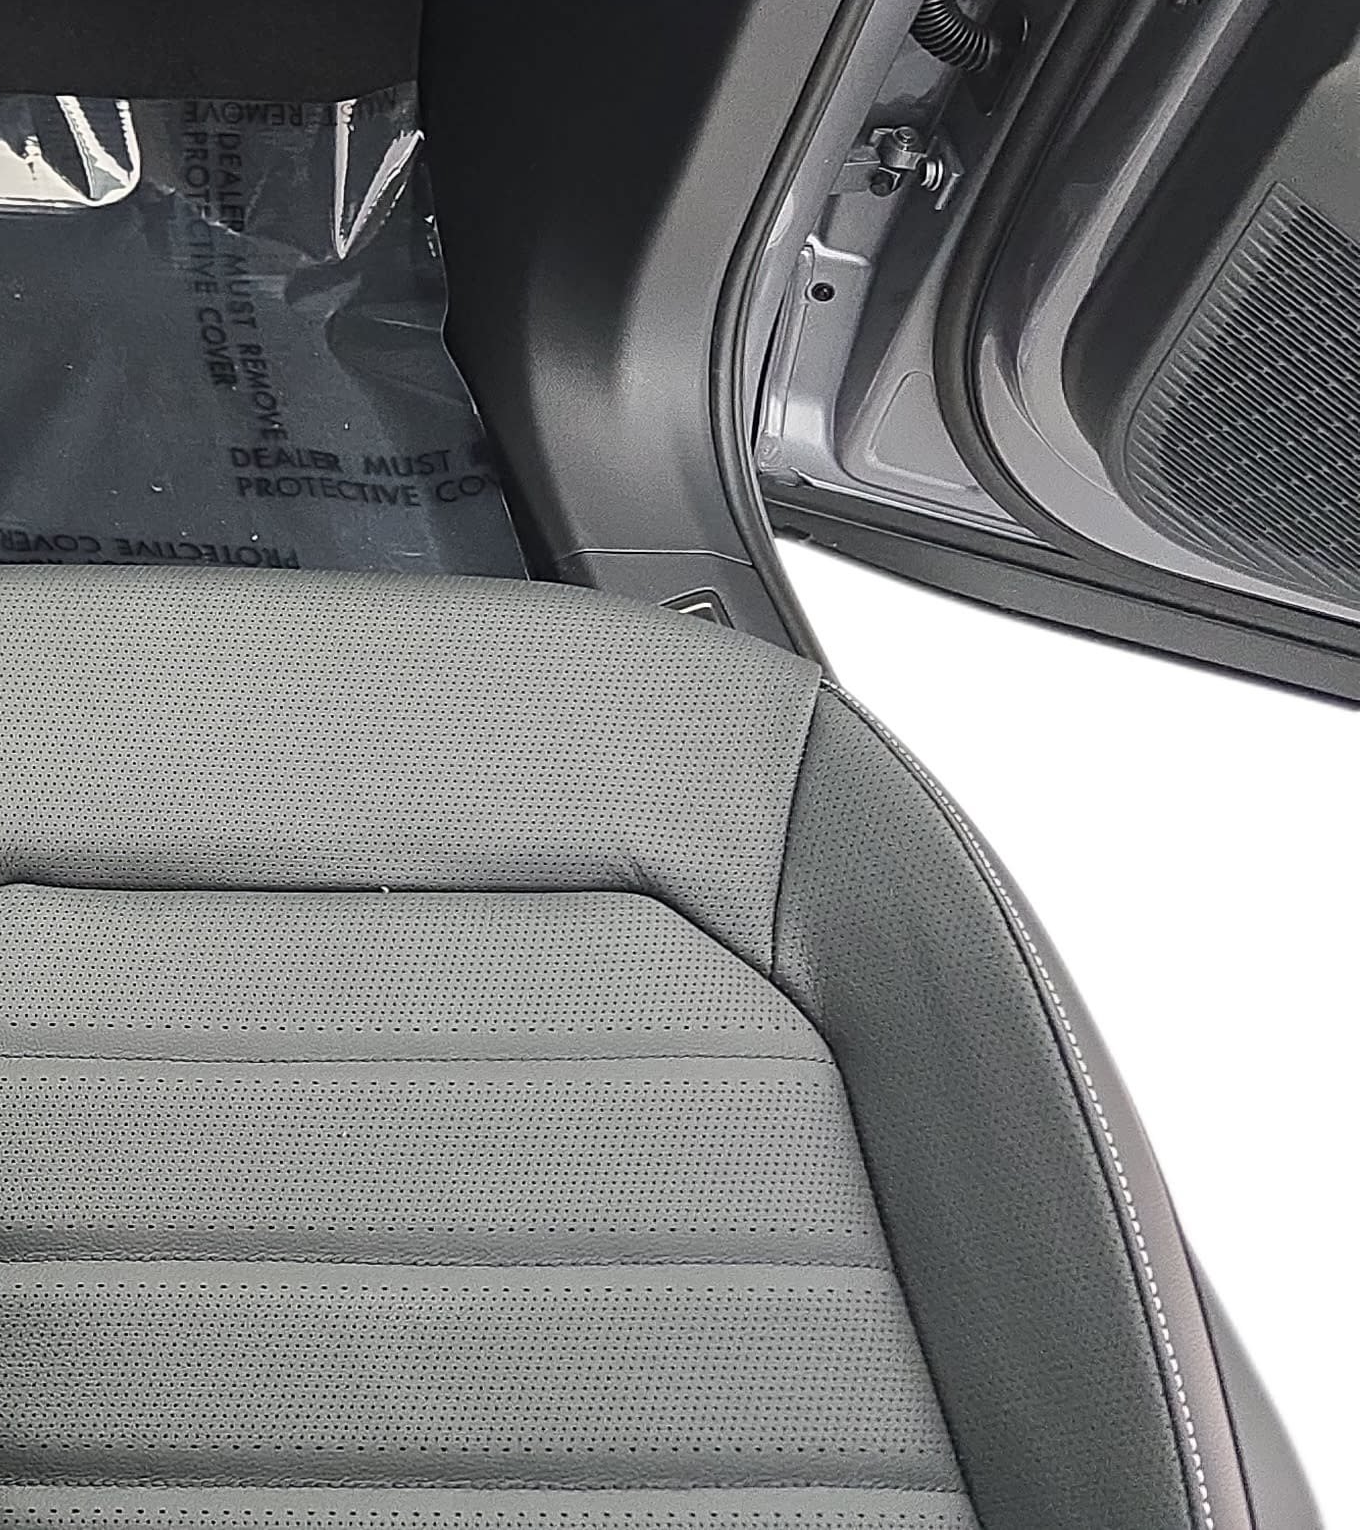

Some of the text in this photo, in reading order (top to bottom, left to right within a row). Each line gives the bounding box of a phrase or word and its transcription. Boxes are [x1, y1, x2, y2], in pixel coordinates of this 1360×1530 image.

[199, 307, 238, 387] COVER
[231, 447, 451, 478] DEALER MUST
[237, 475, 421, 507] PROTECTIVE
